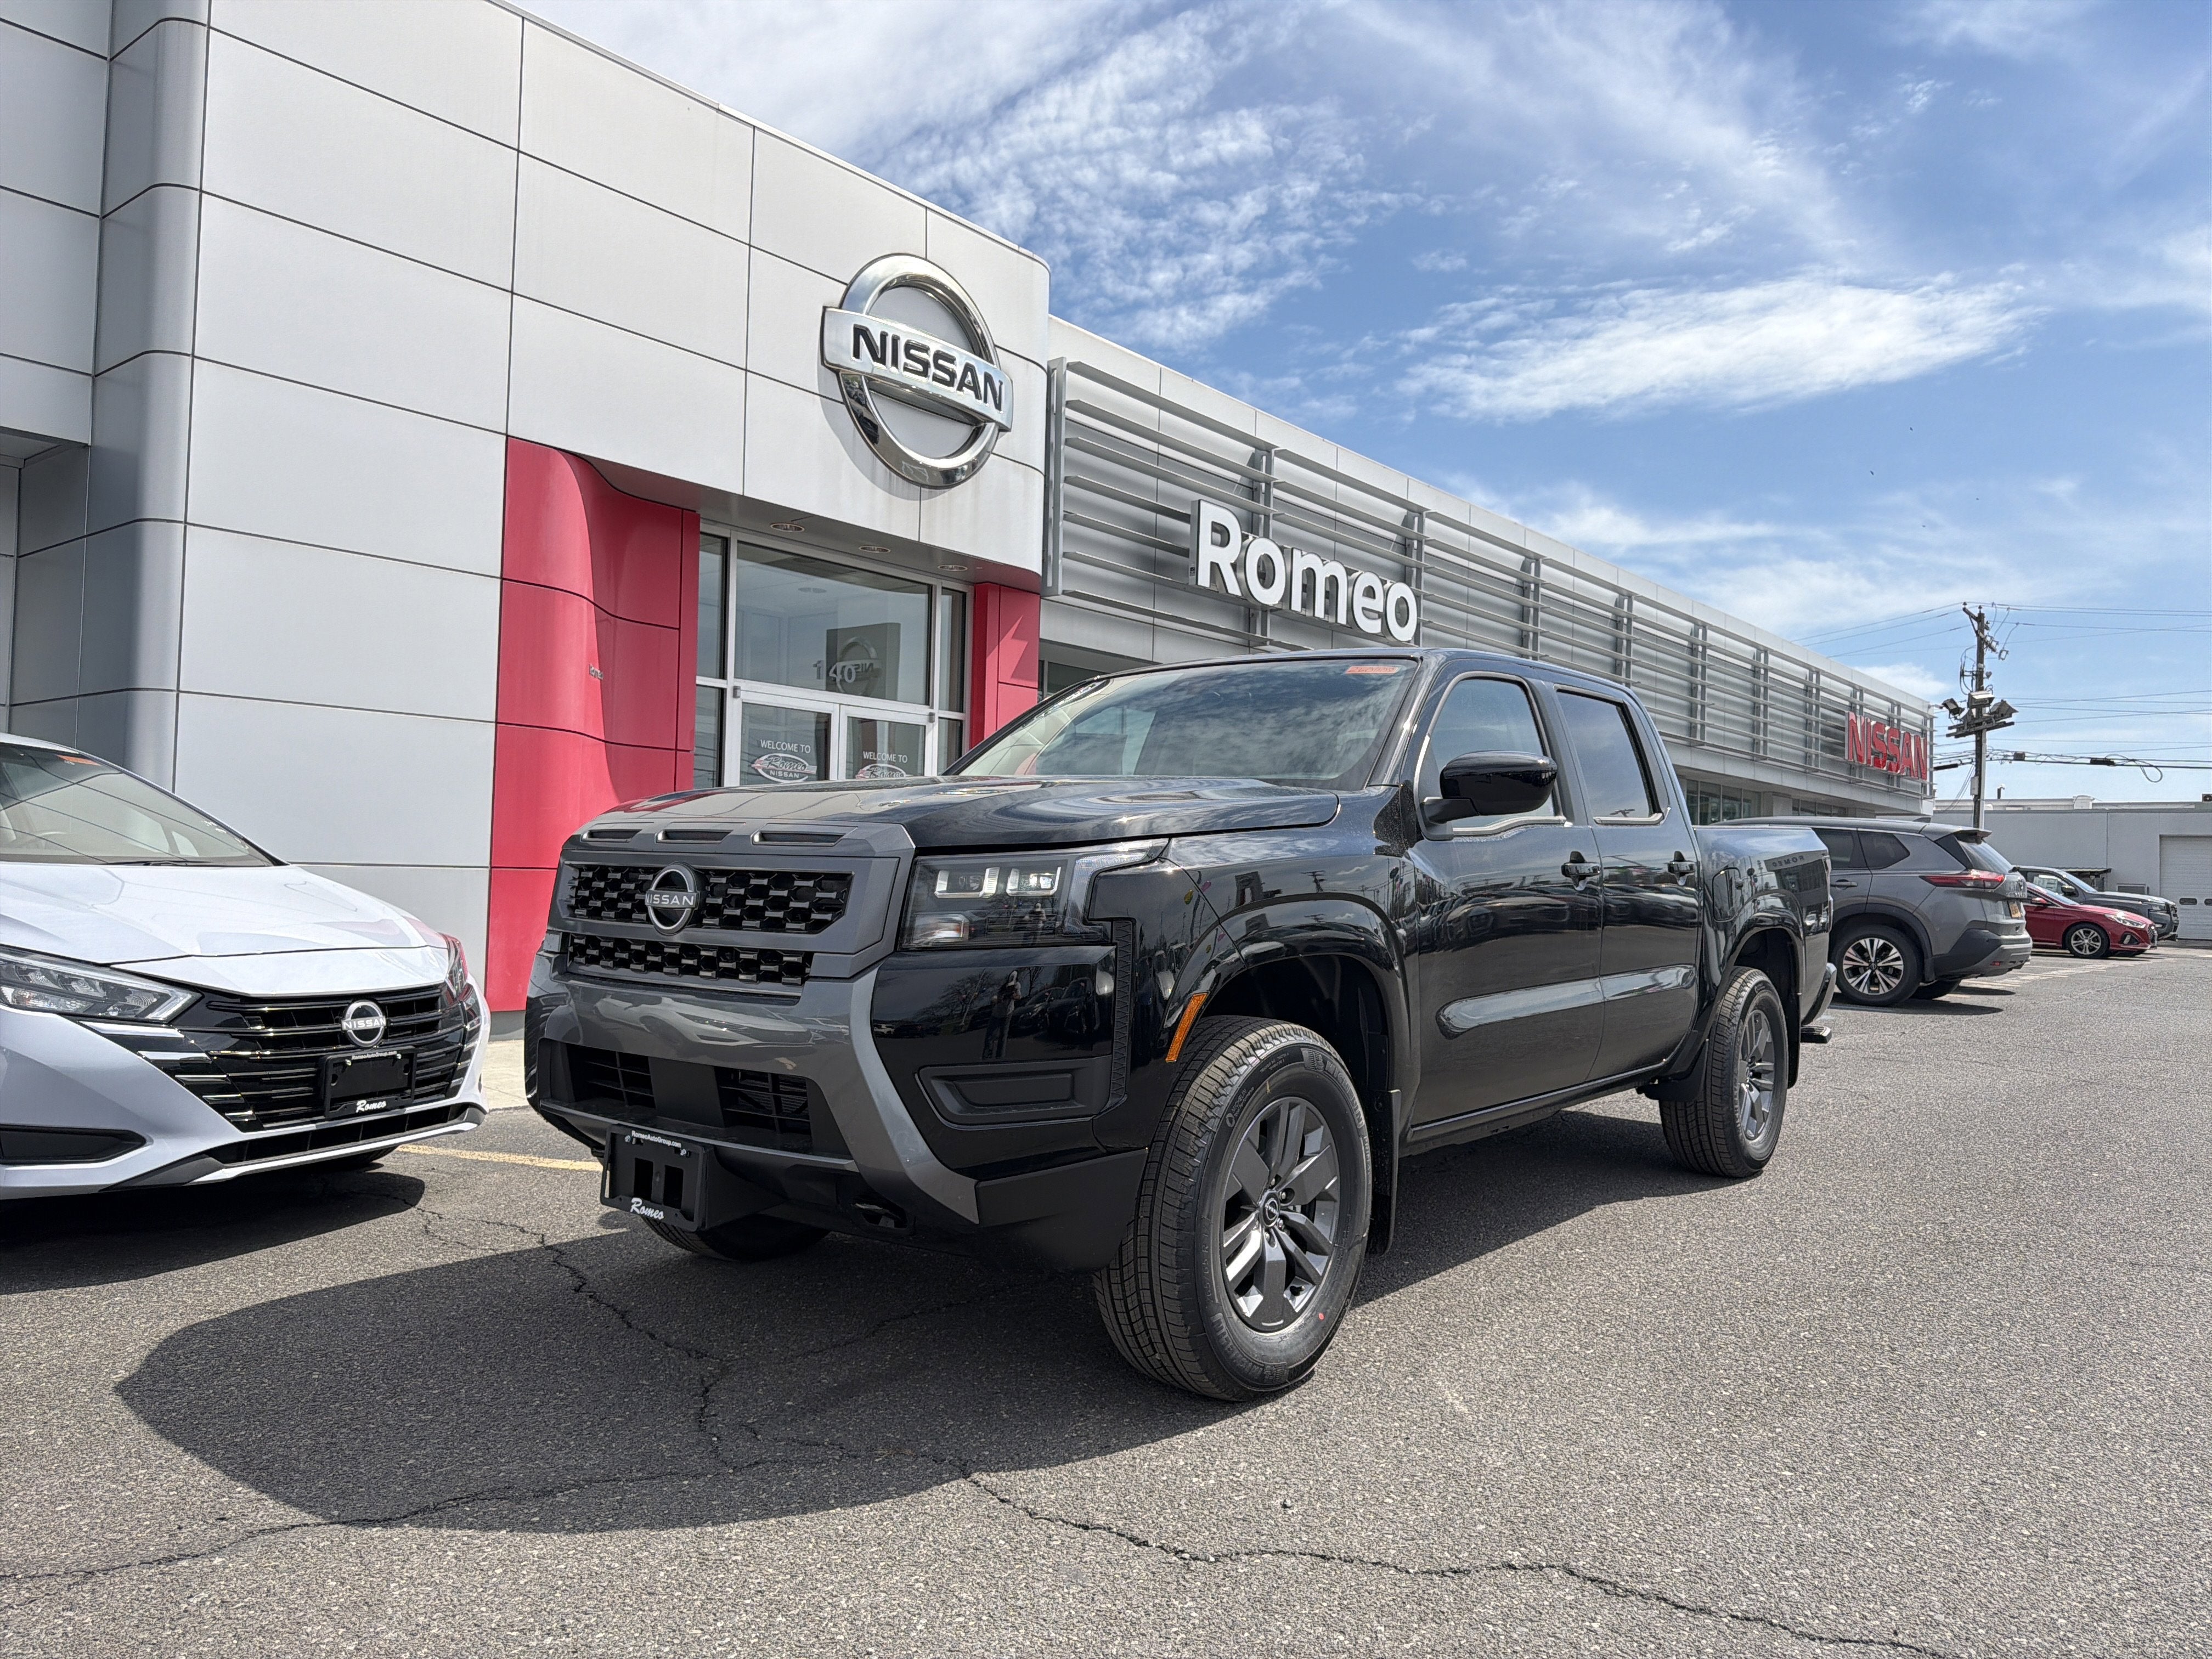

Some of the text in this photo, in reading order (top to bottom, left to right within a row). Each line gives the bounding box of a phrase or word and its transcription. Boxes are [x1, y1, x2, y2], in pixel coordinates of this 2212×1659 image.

[851, 324, 1004, 414] NISSAN
[1195, 499, 1418, 642] Romeo
[813, 660, 856, 683] 140
[760, 739, 811, 754] WELCOME TO
[1847, 711, 1928, 781] NISSAN
[765, 755, 807, 771] Romeo
[863, 751, 908, 763] WELCOME TO
[770, 770, 799, 778] NISSAN
[645, 893, 694, 905] NISSAN
[343, 1018, 386, 1029] NISSAN
[1325, 1060, 1364, 1126] MICHELIN
[356, 1099, 387, 1113] Romeo
[631, 1130, 682, 1148] RomeoAutoGroup.com
[630, 1197, 664, 1220] Romeo
